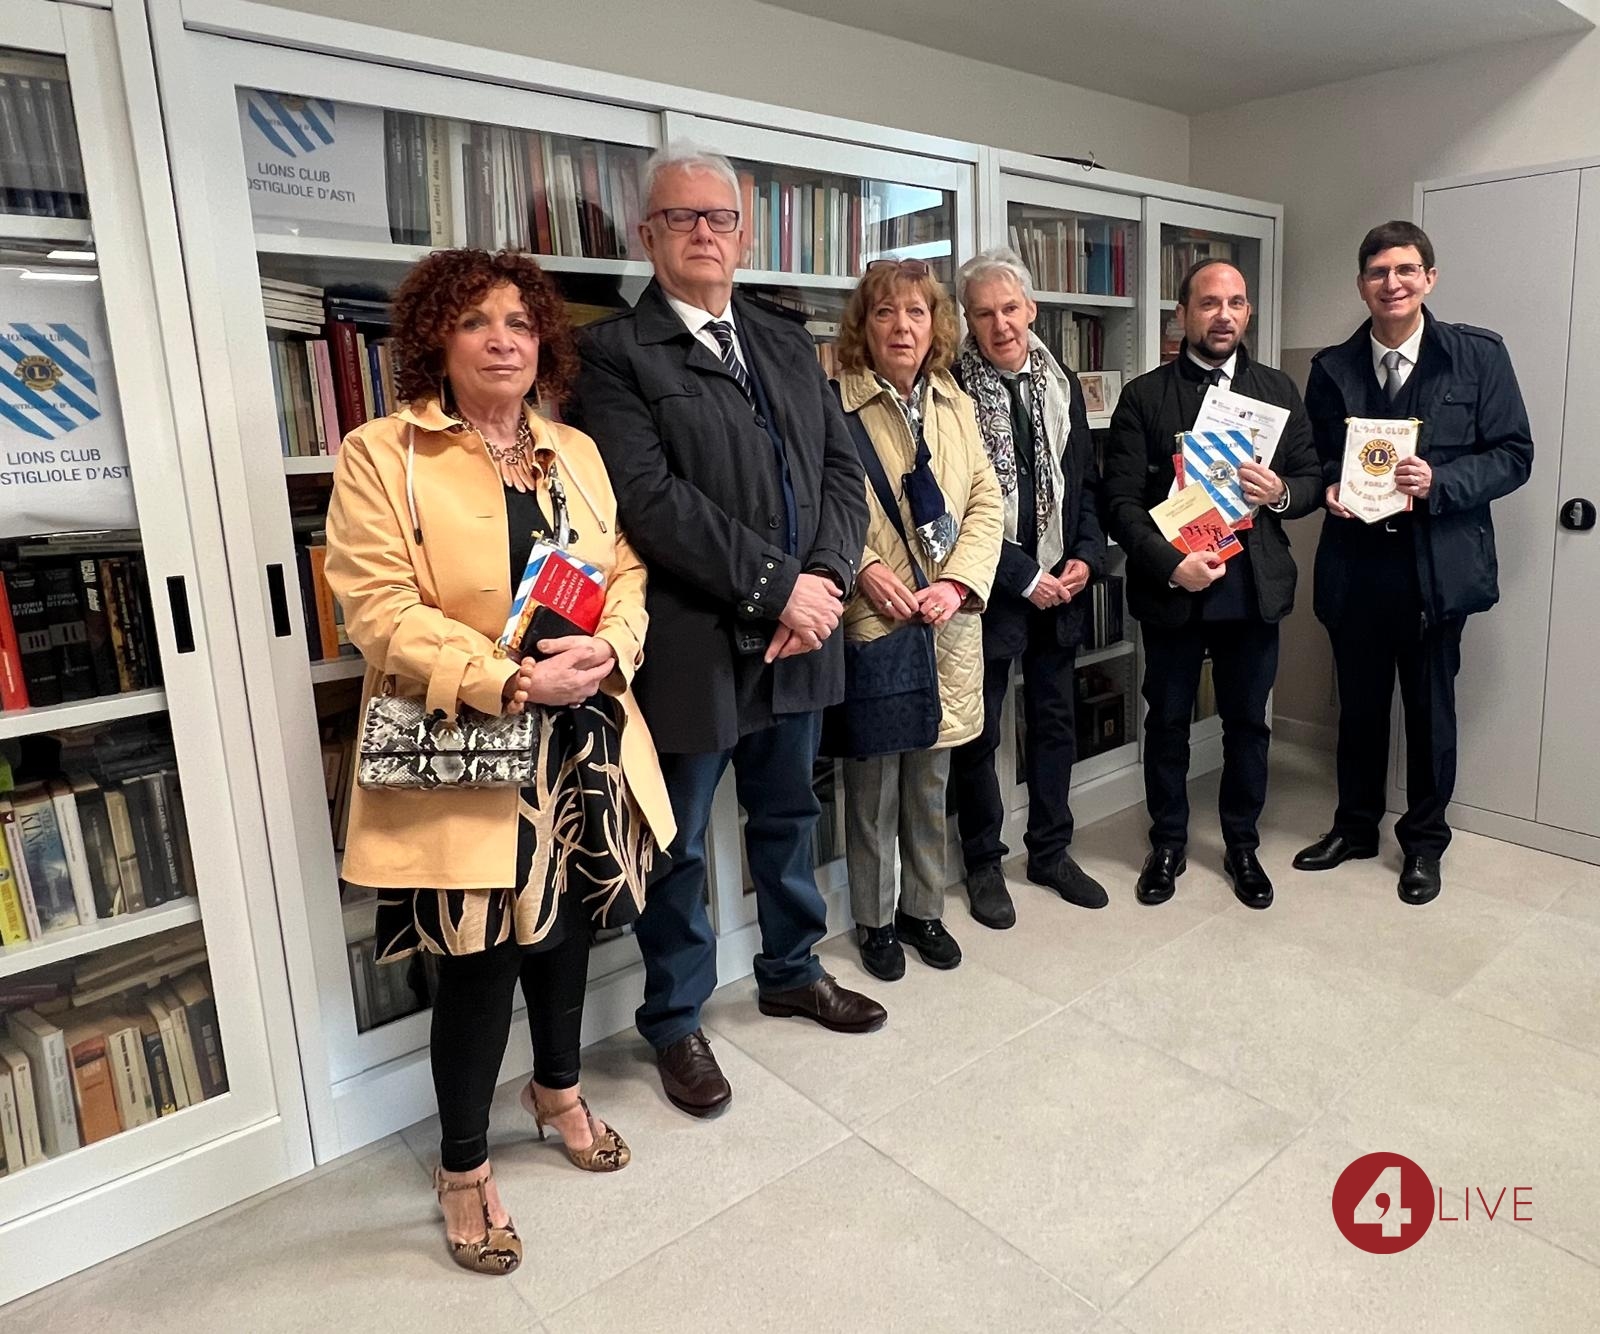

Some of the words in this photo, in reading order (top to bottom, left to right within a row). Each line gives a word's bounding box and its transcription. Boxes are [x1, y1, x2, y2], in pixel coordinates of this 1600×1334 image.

[257, 162, 296, 178] LIONS
[299, 167, 331, 183] CLUB
[246, 176, 314, 198] OSTIGLIOLE
[317, 187, 355, 203] D'ASTI
[33, 366, 46, 379] L
[1385, 426, 1411, 436] CLUB
[1368, 440, 1392, 450] LIONS
[7, 450, 55, 465] LIONS
[61, 448, 101, 463] CLUB
[1373, 450, 1384, 464] L
[0, 469, 81, 485] STIGLIOLE
[86, 466, 129, 480] D'AST
[552, 578, 567, 605] DONNE
[559, 573, 579, 609] VECCHIO
